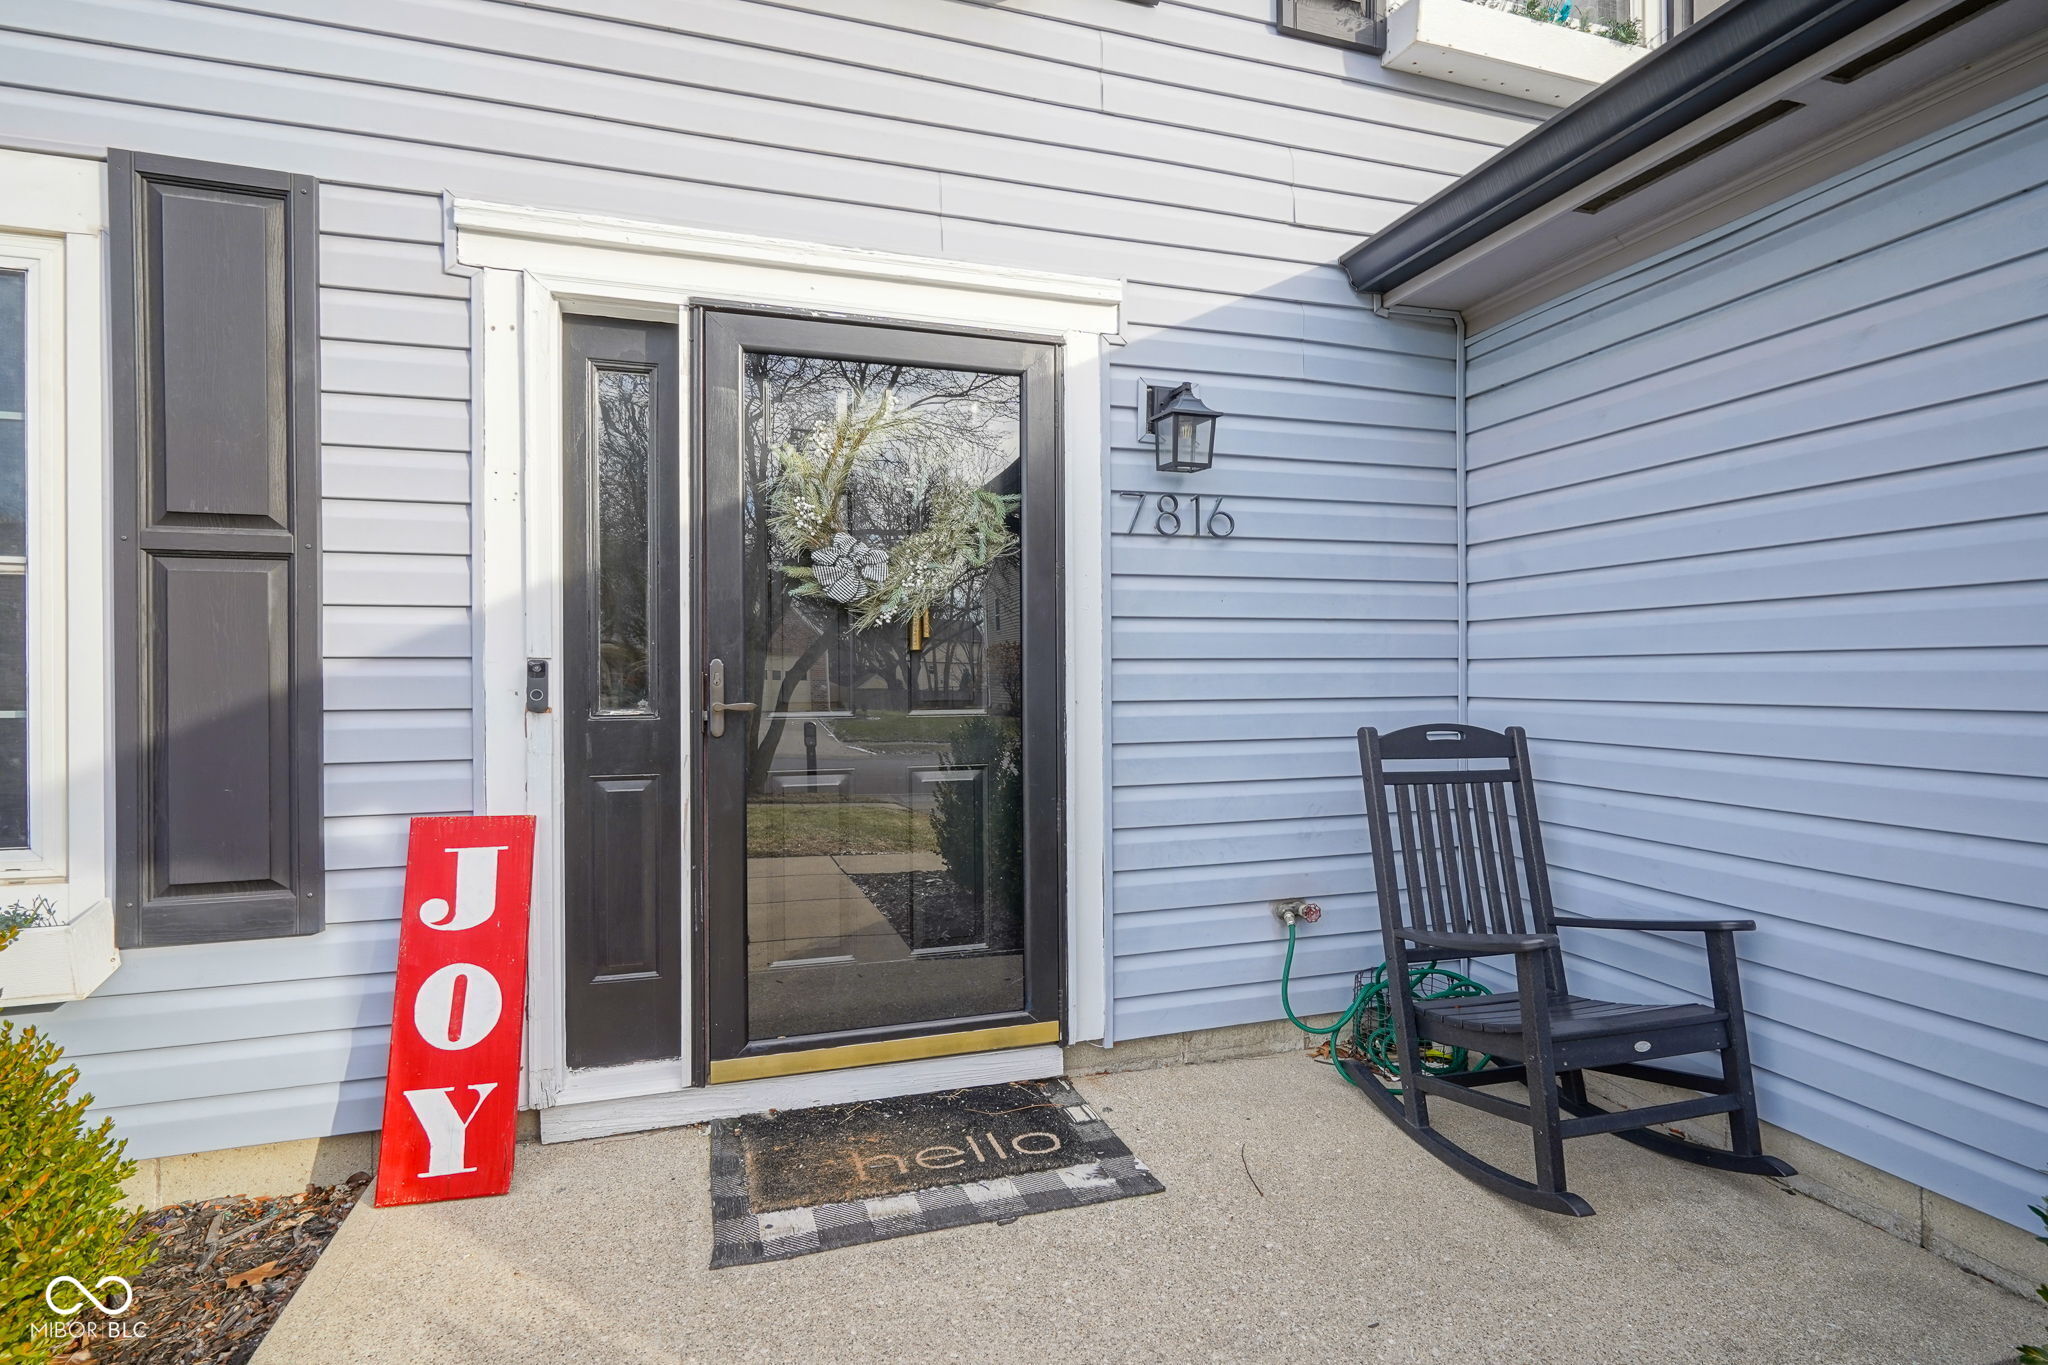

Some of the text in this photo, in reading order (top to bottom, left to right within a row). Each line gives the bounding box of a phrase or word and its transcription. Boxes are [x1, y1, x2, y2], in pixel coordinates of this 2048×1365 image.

[1119, 491, 1235, 537] 7816
[403, 846, 509, 1178] JOY
[852, 1132, 1061, 1181] hello
